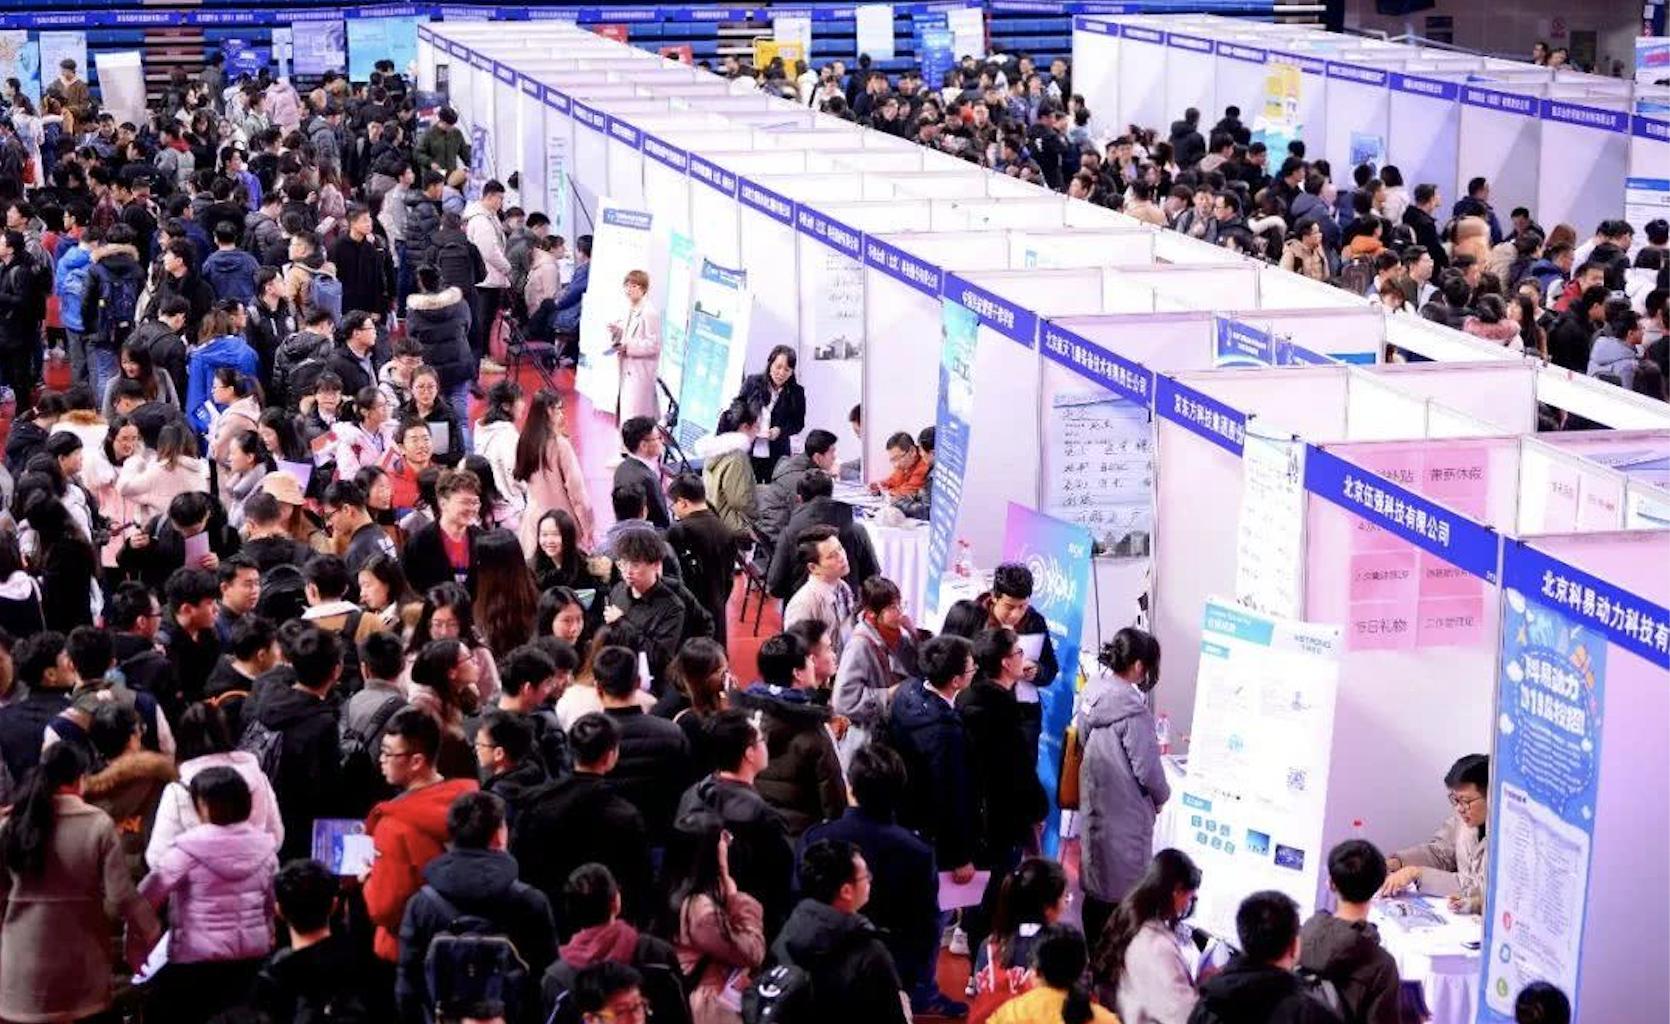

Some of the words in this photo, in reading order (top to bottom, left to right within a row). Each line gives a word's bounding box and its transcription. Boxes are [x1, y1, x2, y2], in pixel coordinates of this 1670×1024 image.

[1343, 474, 1450, 547] 北京伍强科技有限公司
[1541, 569, 1670, 653] 北京科易动力科技有
